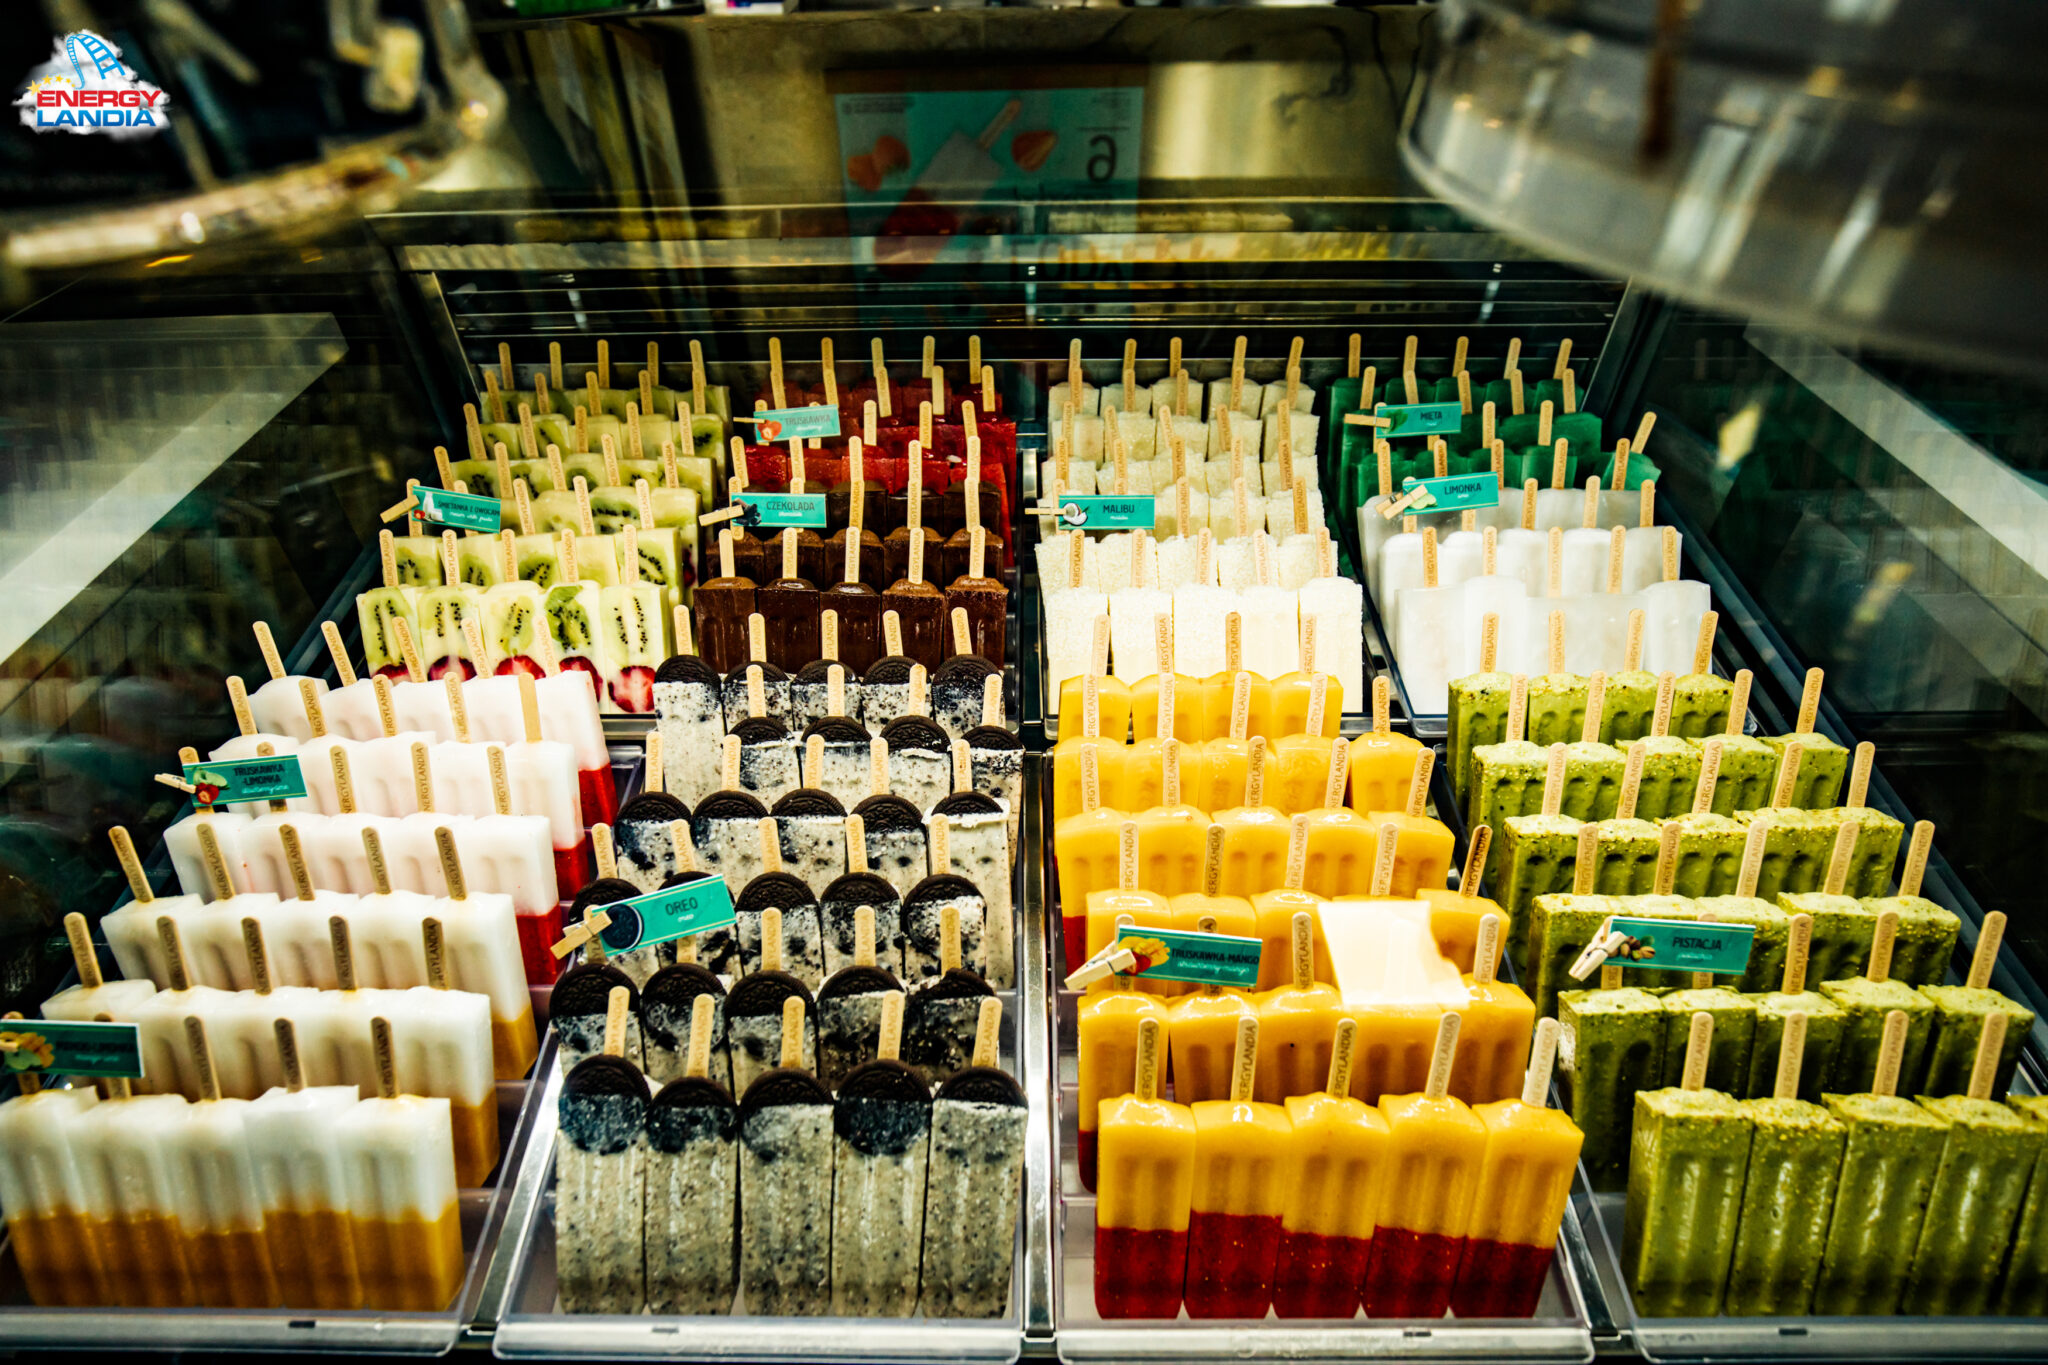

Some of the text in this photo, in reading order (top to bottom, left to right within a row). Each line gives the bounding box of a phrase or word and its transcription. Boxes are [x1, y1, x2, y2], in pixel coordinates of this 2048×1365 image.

[1444, 483, 1482, 496] LIMONKA
[766, 501, 815, 511] CZEKOLADA
[1103, 504, 1135, 514] MALIBU
[665, 897, 699, 916] OREO
[1672, 936, 1722, 951] PISTACJA
